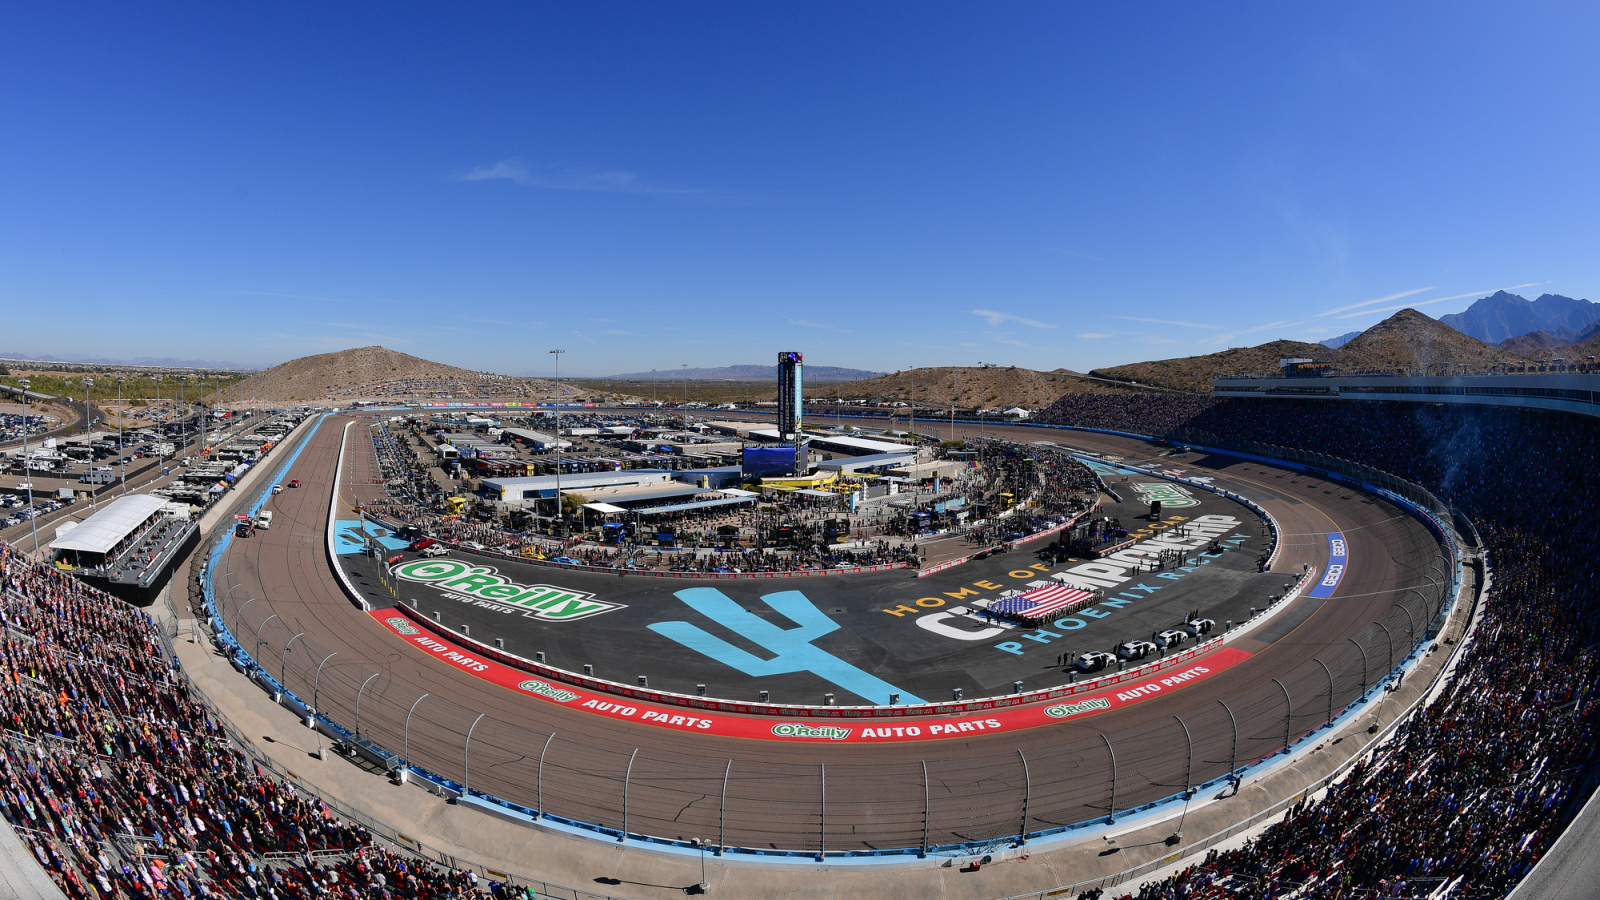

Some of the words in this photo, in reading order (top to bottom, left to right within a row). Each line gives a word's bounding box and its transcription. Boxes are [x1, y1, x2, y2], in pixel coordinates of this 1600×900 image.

[1332, 539, 1345, 556] GEICO
[401, 560, 603, 617] O'Reilly
[882, 580, 1004, 617] HOME
[1008, 563, 1050, 578] OF
[1322, 564, 1344, 586] GEICO
[440, 592, 474, 606] AUTO
[473, 600, 515, 614] PARTS
[994, 583, 1162, 656] PHOENIX
[414, 636, 444, 652] AUTO
[443, 651, 489, 672] PARTS
[519, 680, 579, 702] O'Reilly
[582, 699, 637, 716] AUTO
[641, 710, 713, 729] PARTS
[1047, 699, 1108, 717] O'Reilly
[1117, 682, 1162, 702] AUTO
[1160, 666, 1210, 687] PARTS
[774, 724, 848, 738] O'Reilly
[861, 726, 921, 738] AUTO
[930, 719, 1002, 735] PARTS
